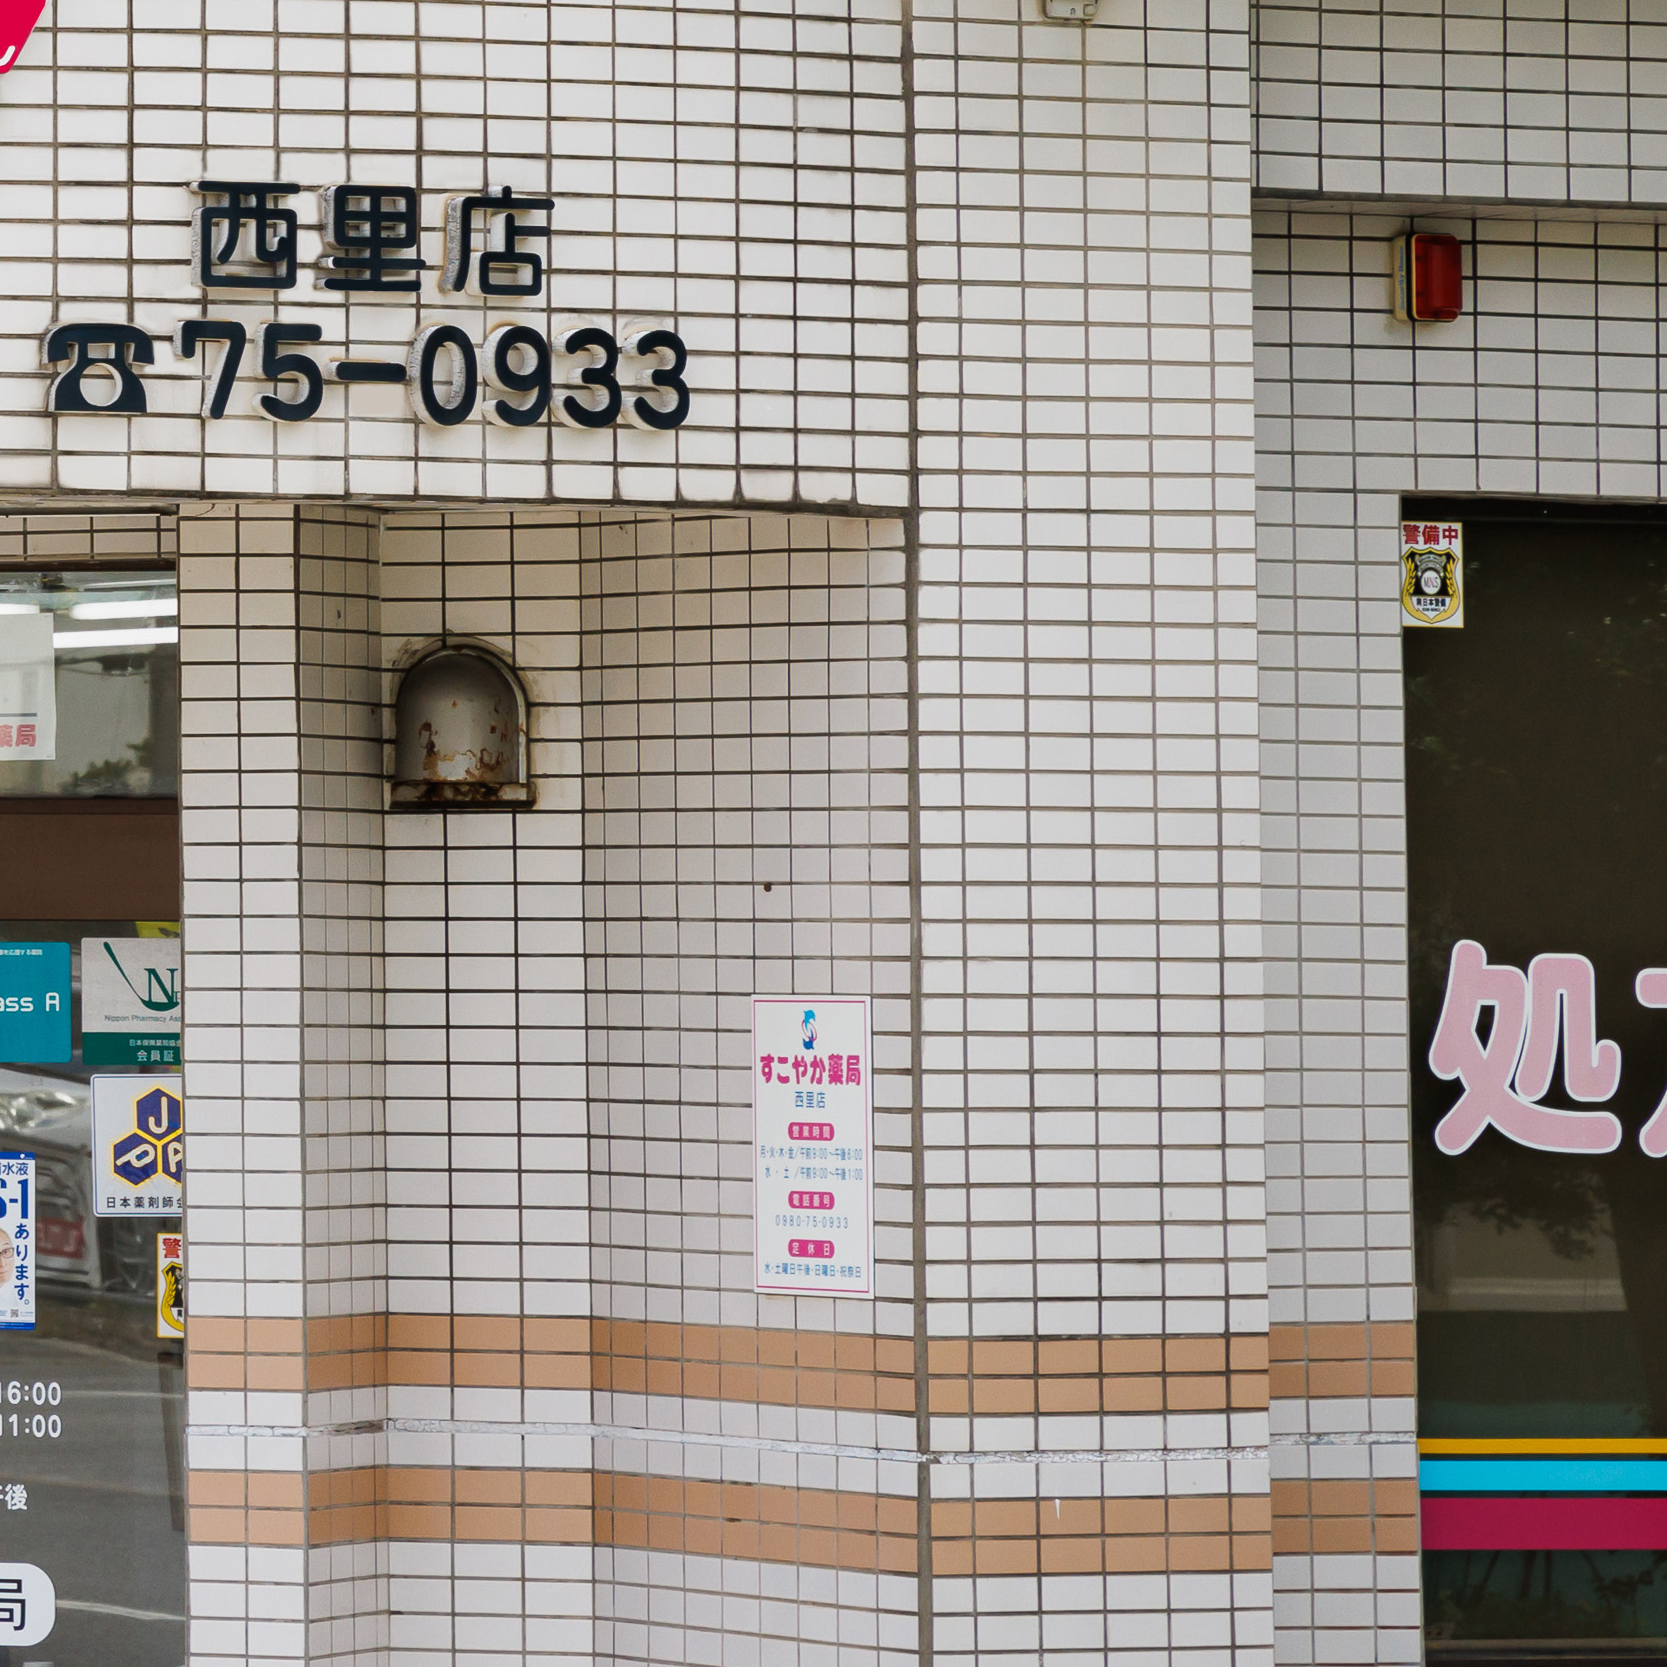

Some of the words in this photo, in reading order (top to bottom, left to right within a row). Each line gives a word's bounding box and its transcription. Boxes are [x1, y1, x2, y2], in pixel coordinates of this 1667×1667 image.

[190, 181, 556, 297] 西里店
[173, 319, 690, 431] 75-0933
[1403, 524, 1459, 546] 警備中
[45, 992, 60, 1012] A
[131, 1015, 167, 1023] Pharmacy
[137, 1049, 175, 1062] 会員証
[760, 1053, 861, 1086] すこやか薬局
[794, 1091, 826, 1109] 西里店
[792, 1125, 831, 1139] 営業時間
[792, 1193, 830, 1208] 電話番号
[775, 1215, 849, 1229] 0980-75-0933
[792, 1242, 830, 1256] 定休日
[14, 1222, 30, 1305] あります。
